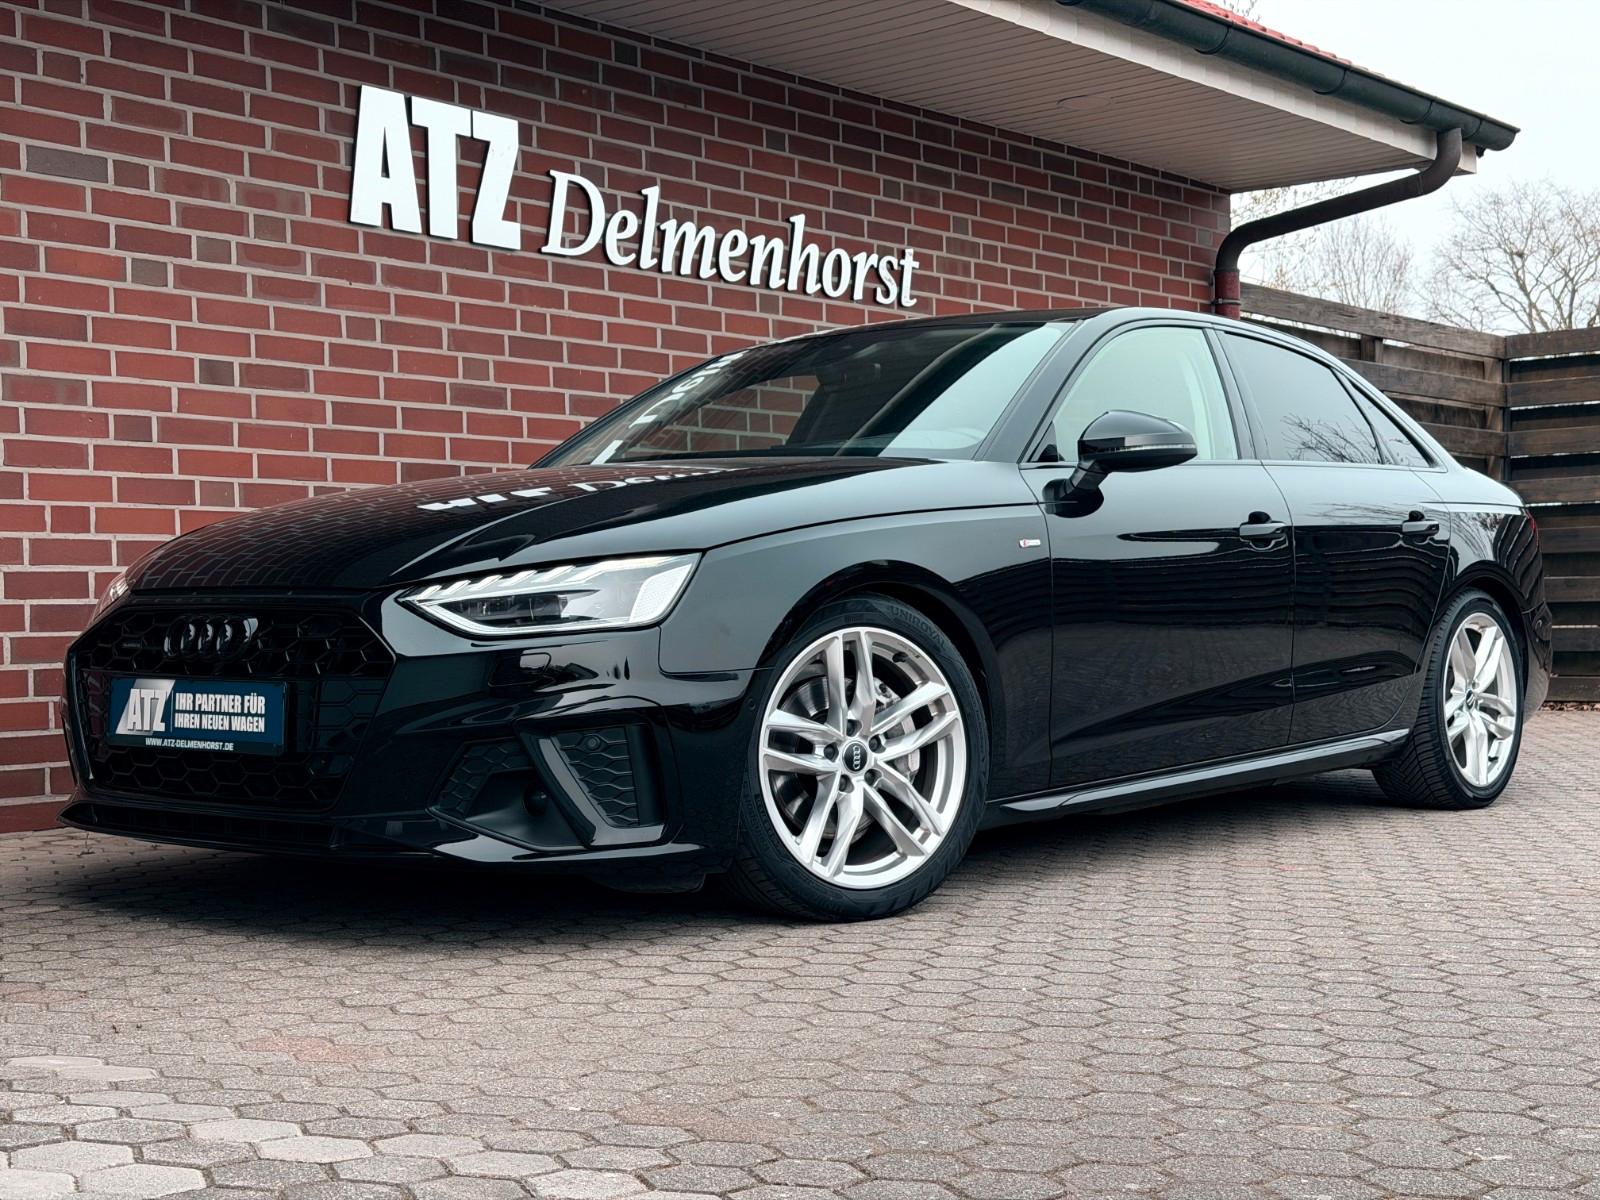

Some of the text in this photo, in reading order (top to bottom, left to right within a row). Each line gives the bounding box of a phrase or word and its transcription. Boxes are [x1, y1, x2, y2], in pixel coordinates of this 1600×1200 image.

[350, 85, 919, 307] ATZ Delmenhorst
[890, 605, 946, 651] UNIROYAL
[127, 688, 168, 732] ATZ
[175, 692, 265, 714] IHR PARTNER FÜR
[174, 713, 265, 733] IHREN NEUEN WAGEN
[145, 737, 234, 751] WWW.ATZ-DELMENHORST.DE
